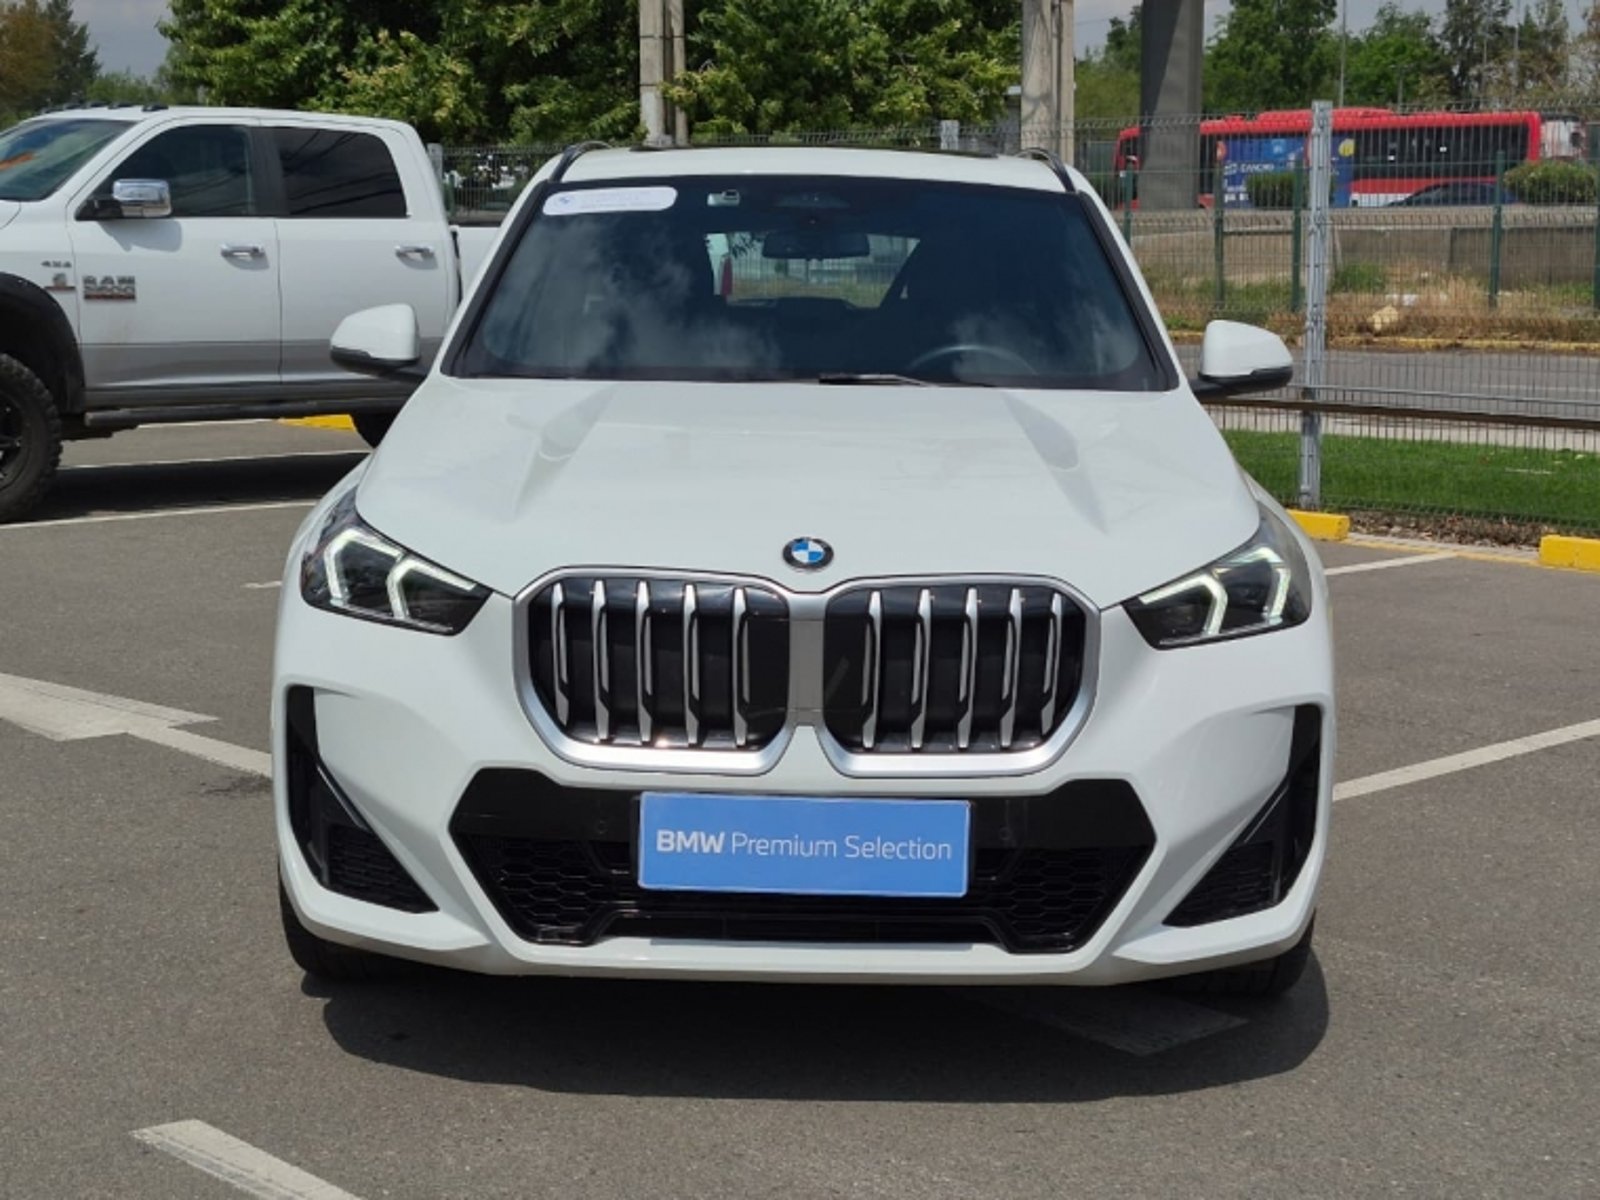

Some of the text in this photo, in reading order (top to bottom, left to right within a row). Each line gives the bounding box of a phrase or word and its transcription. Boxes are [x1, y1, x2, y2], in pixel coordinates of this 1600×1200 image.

[656, 829, 952, 860] BMW Premium Selection
